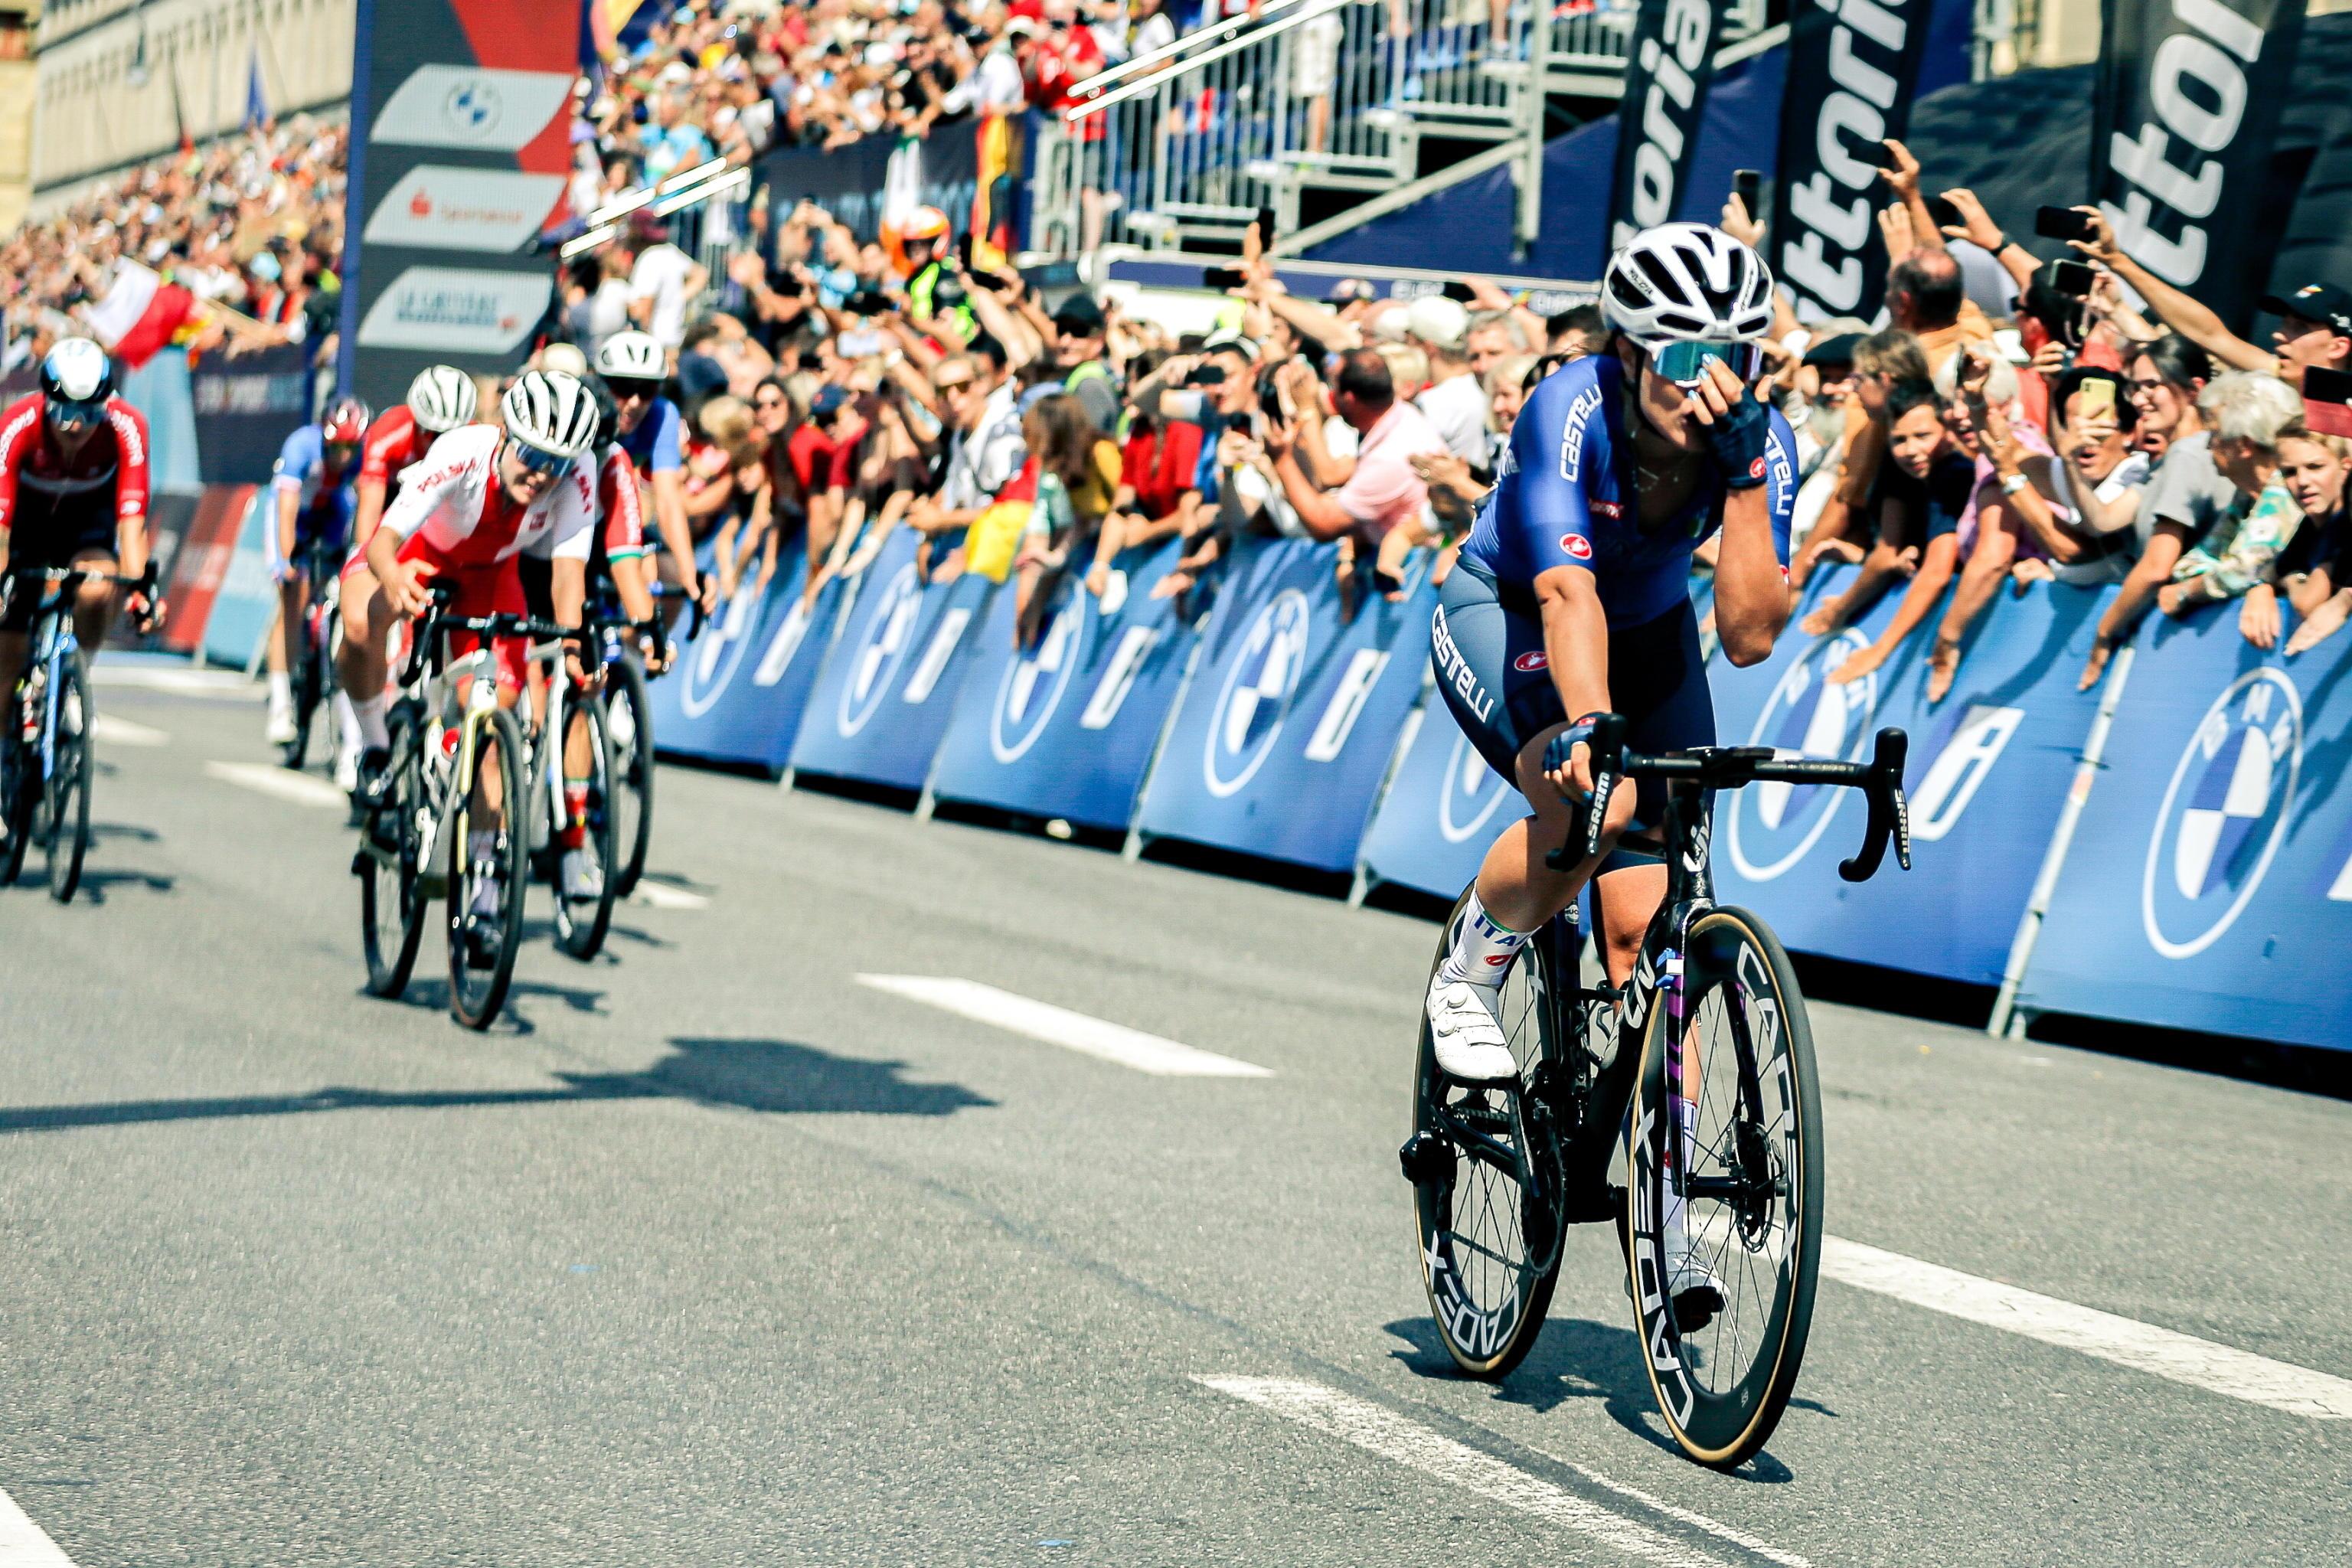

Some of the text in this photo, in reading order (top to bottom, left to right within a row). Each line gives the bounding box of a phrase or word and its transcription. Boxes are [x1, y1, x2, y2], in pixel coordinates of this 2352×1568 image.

[1432, 603, 1495, 724] CASTELLI
[1587, 771, 1611, 840] SRAM
[1893, 788, 1910, 854] SRAM
[1422, 1230, 1520, 1355] CADEX
